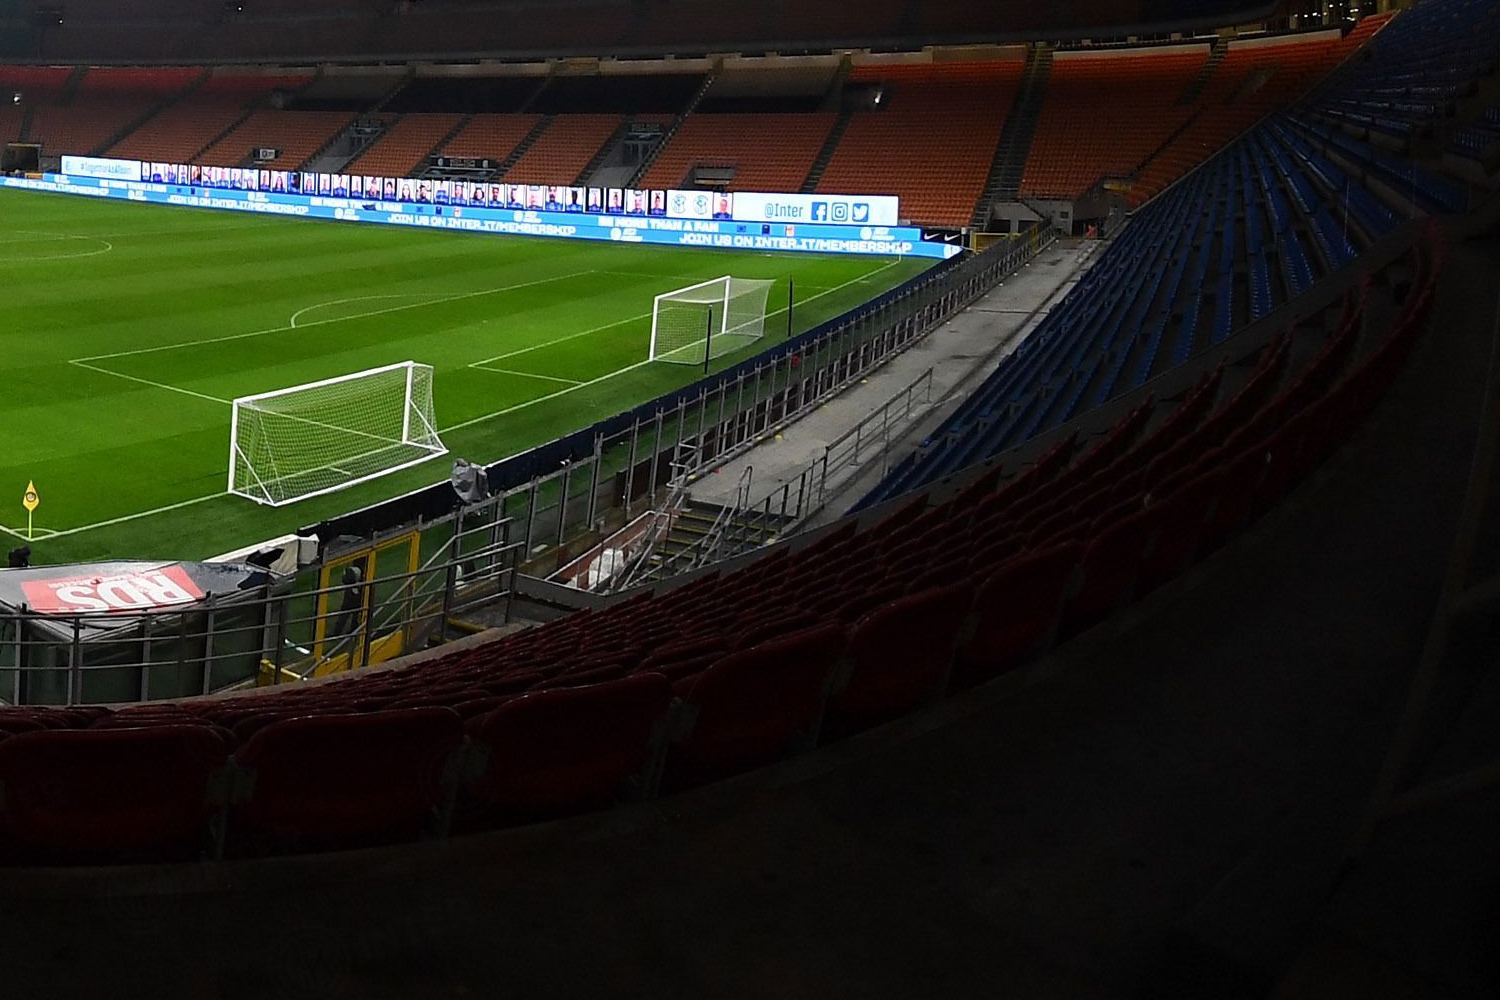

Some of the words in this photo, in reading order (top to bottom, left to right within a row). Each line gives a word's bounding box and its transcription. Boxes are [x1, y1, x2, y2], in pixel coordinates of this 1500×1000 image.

[764, 202, 804, 219] @Inter
[387, 213, 414, 224] JOIN
[415, 215, 429, 226] US
[430, 216, 446, 227] ON
[649, 219, 681, 231] THAN
[679, 232, 713, 245] JOIN
[714, 234, 732, 246] US
[733, 235, 753, 247] ON
